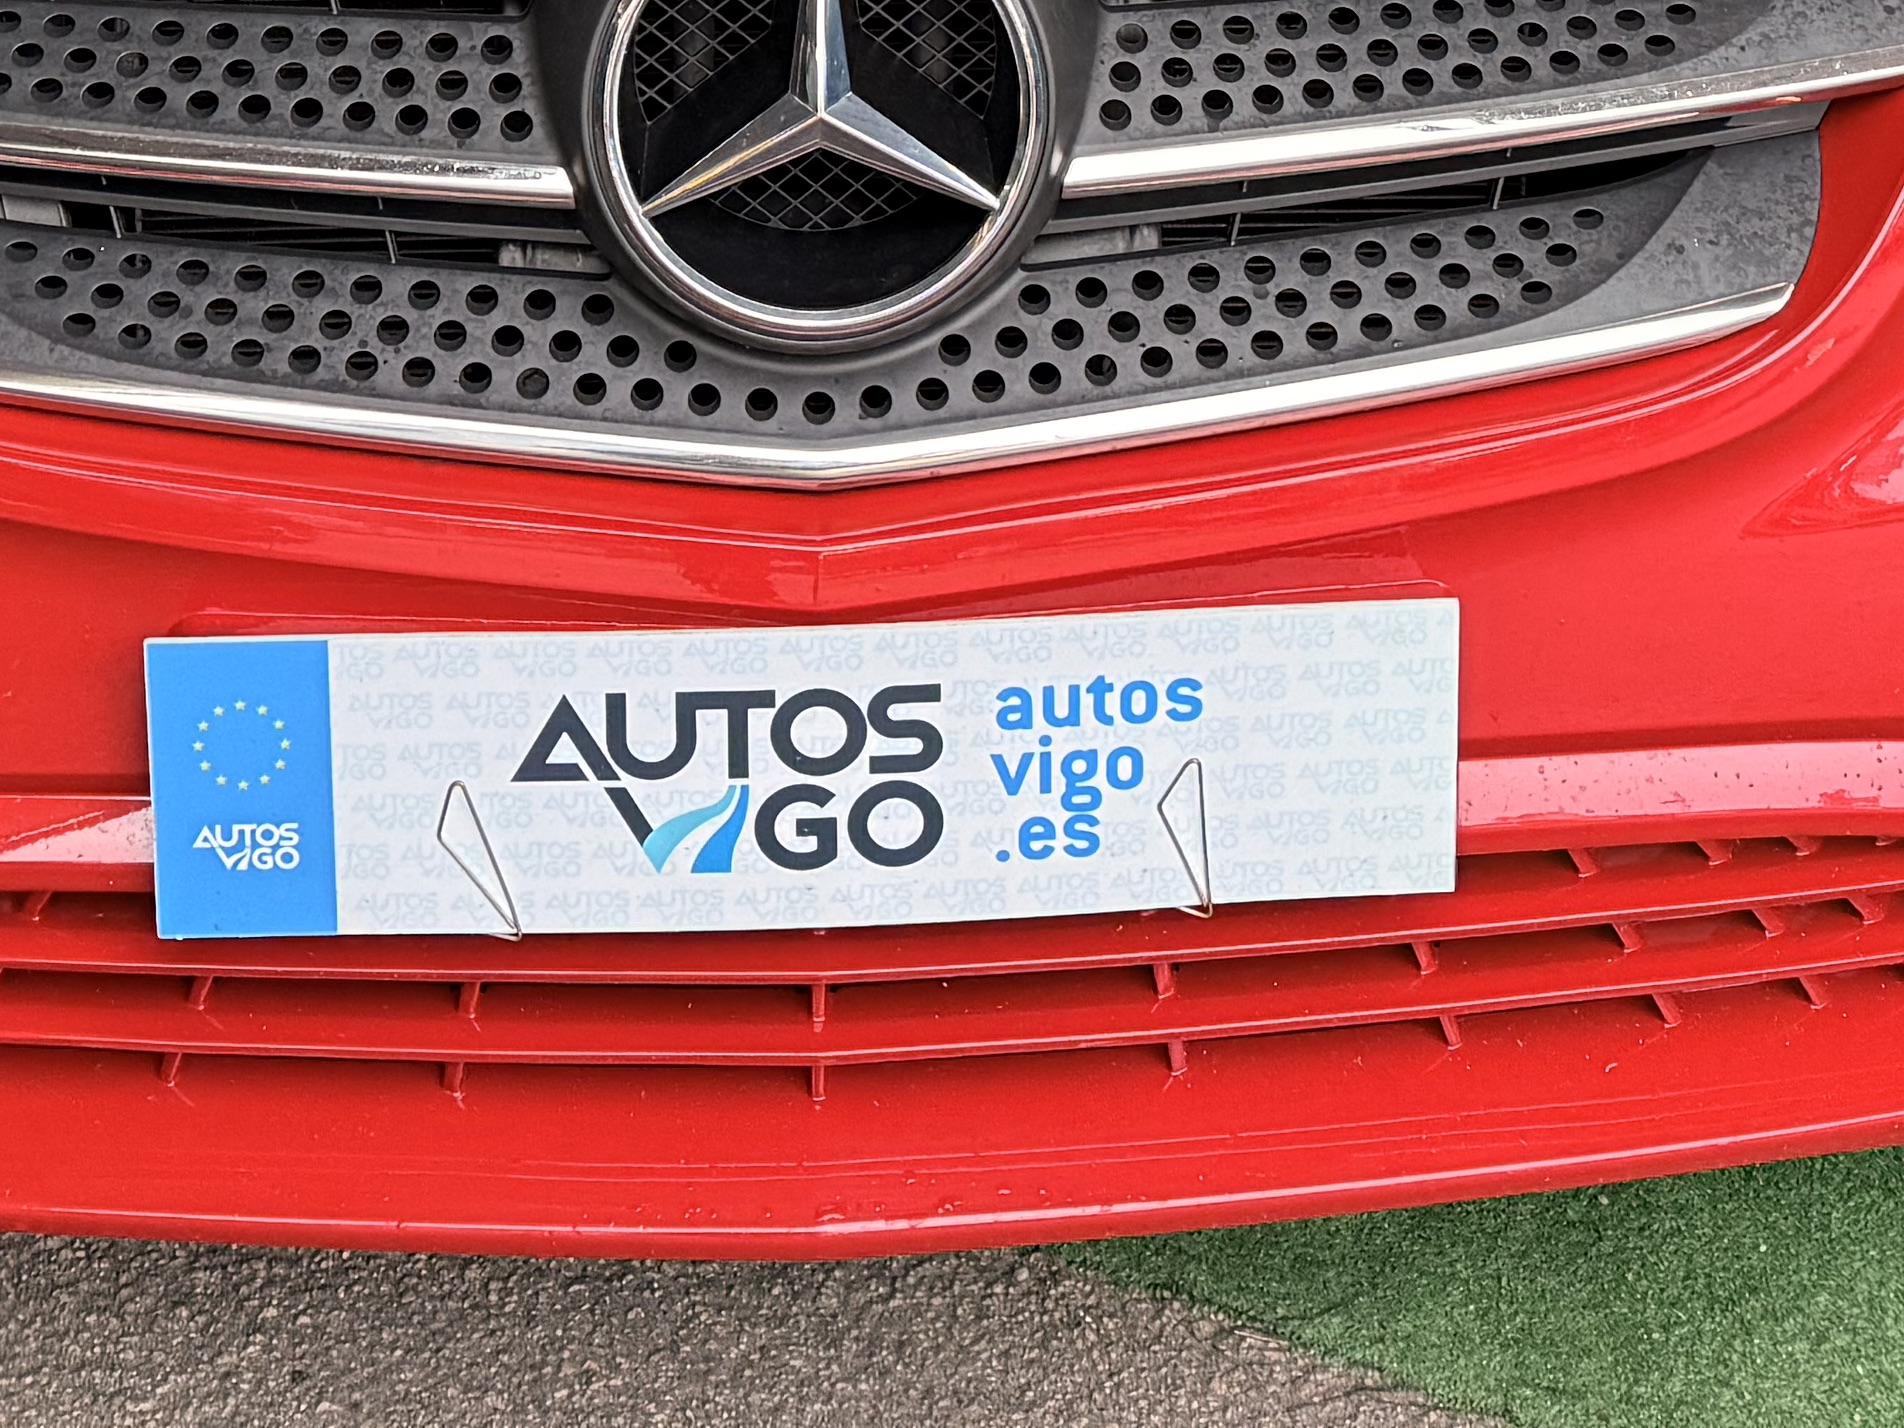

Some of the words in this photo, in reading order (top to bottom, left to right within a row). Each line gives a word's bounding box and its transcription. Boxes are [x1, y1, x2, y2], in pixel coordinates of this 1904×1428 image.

[995, 674, 1204, 732] autos
[509, 682, 944, 783] AUTOS
[989, 734, 1146, 813] vigo
[192, 822, 301, 848] AUTOS
[602, 779, 945, 875] VIGO
[995, 812, 1102, 862] .es
[214, 846, 302, 871] VIGO
